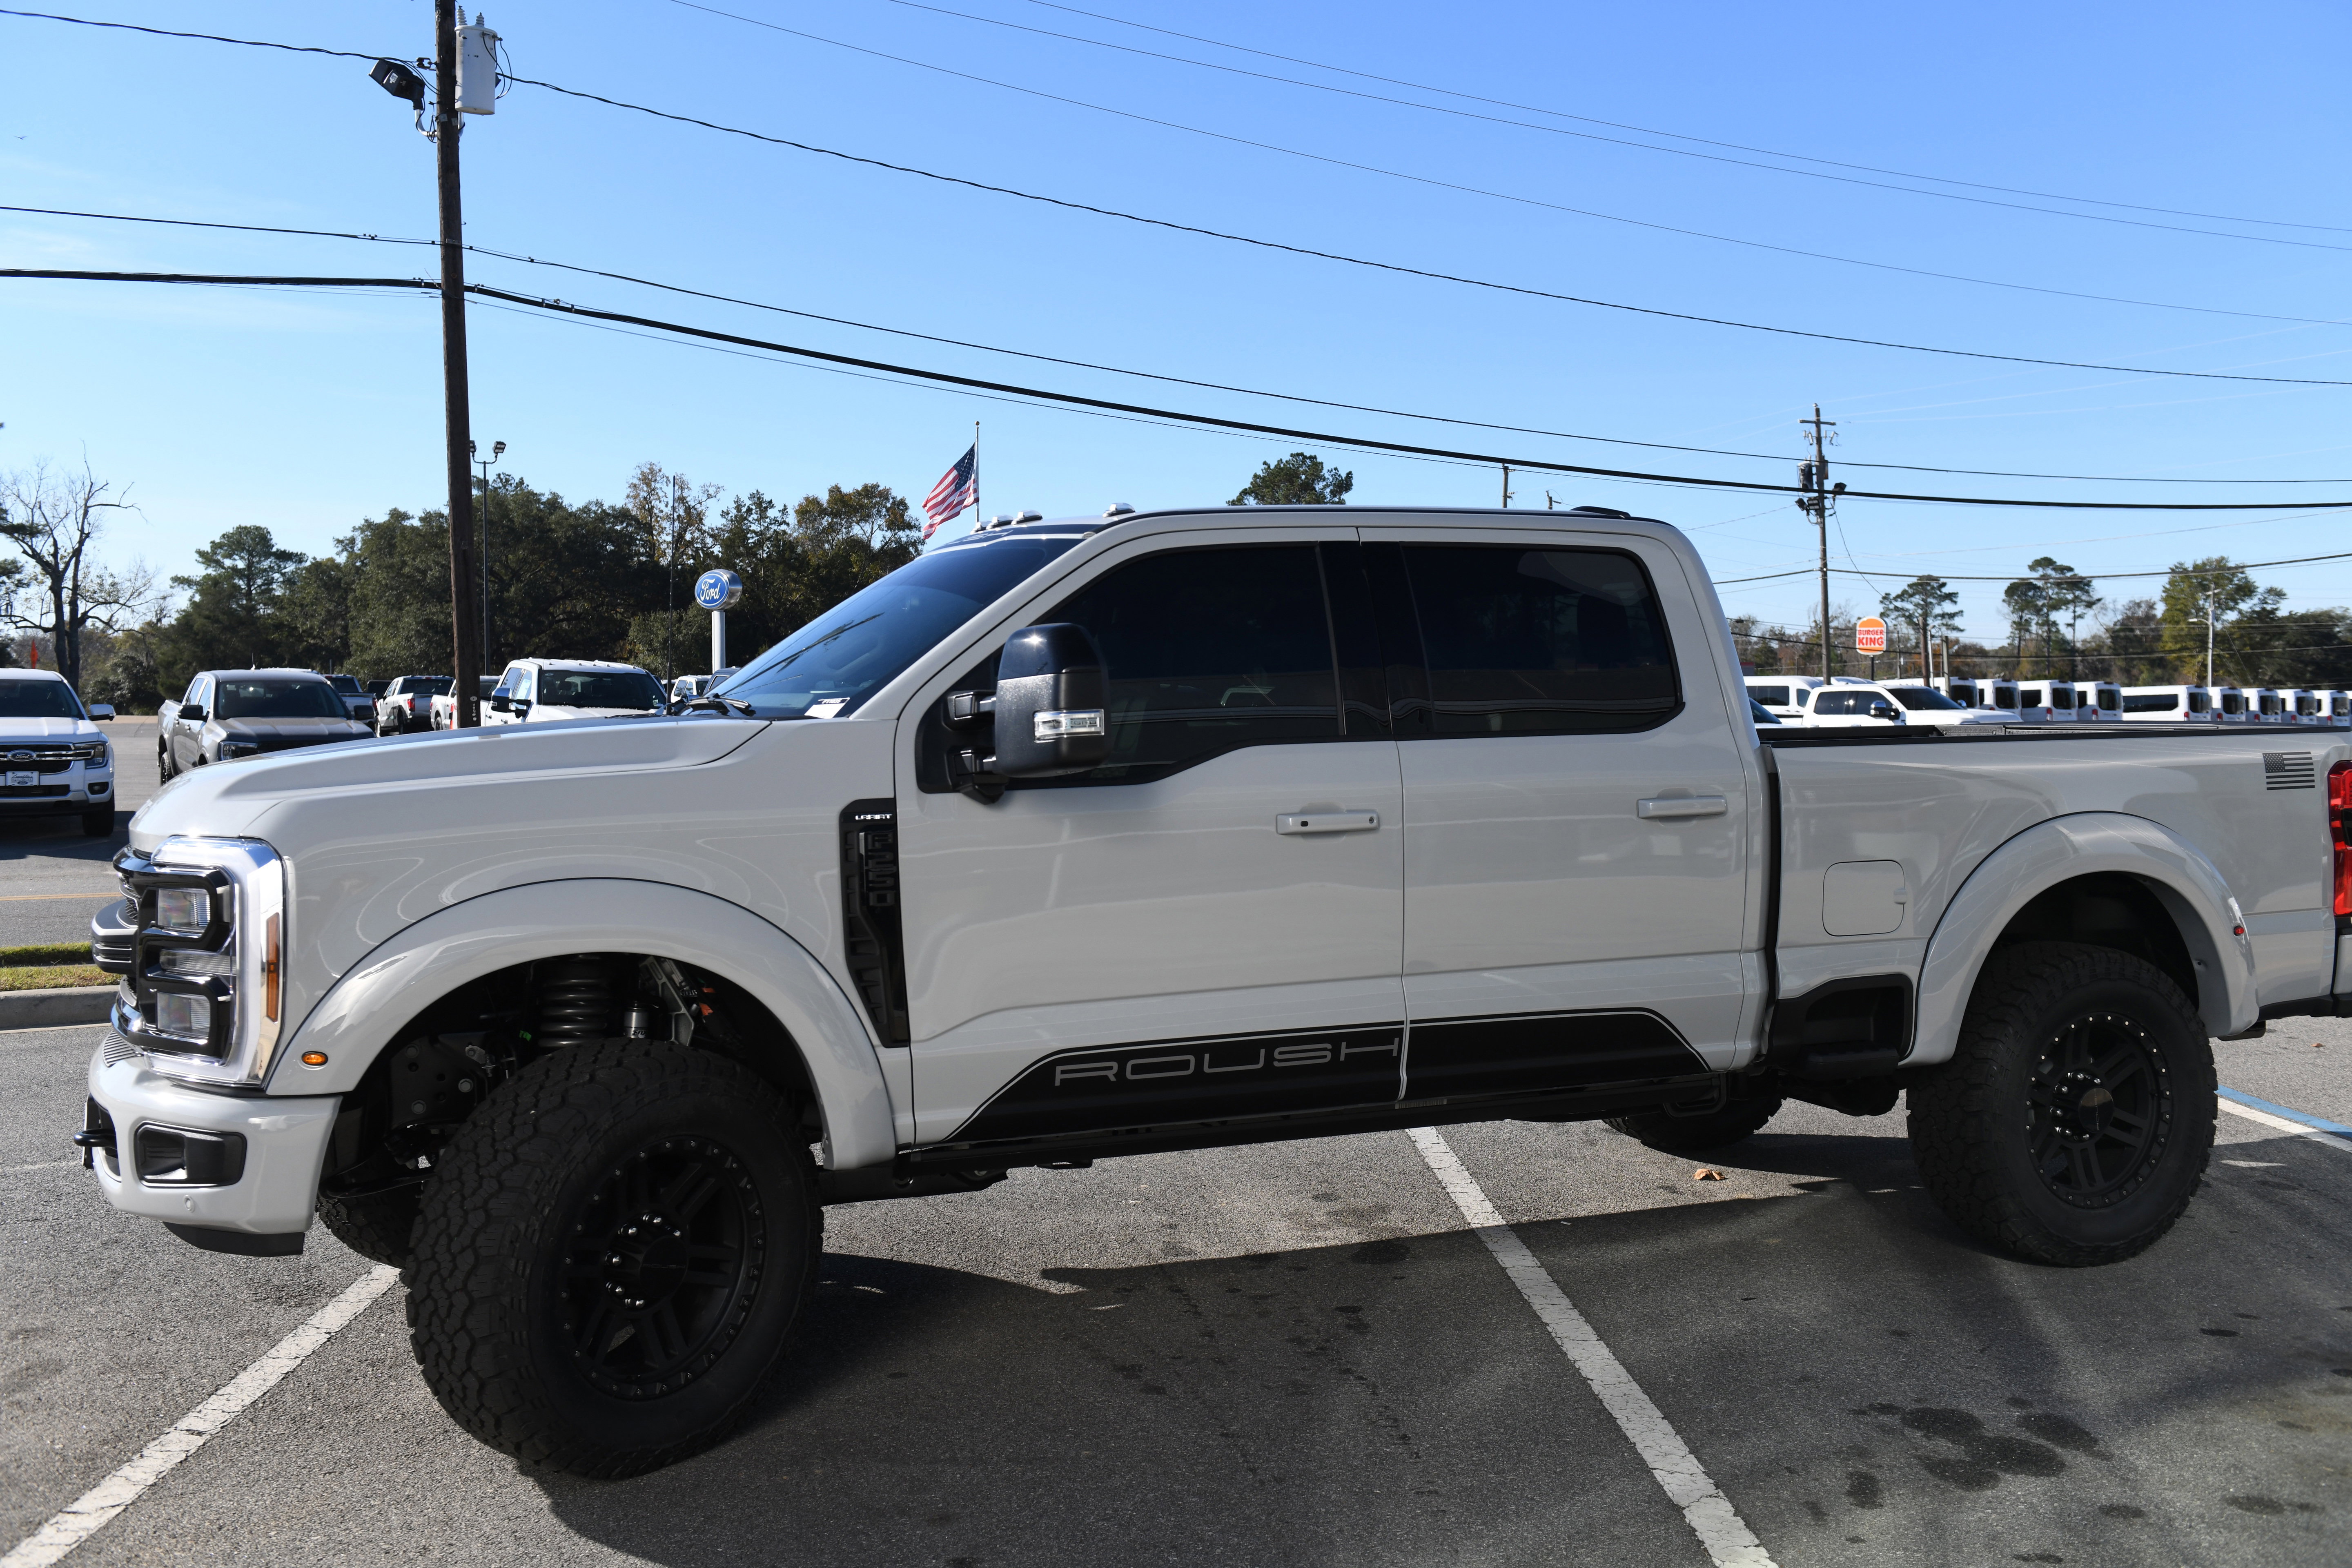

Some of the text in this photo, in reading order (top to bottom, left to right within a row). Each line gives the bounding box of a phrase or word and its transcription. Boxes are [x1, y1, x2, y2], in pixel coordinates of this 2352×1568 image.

[700, 578, 720, 601] Ford
[1858, 637, 1884, 646] KING
[1055, 1037, 1399, 1086] ROUSH
